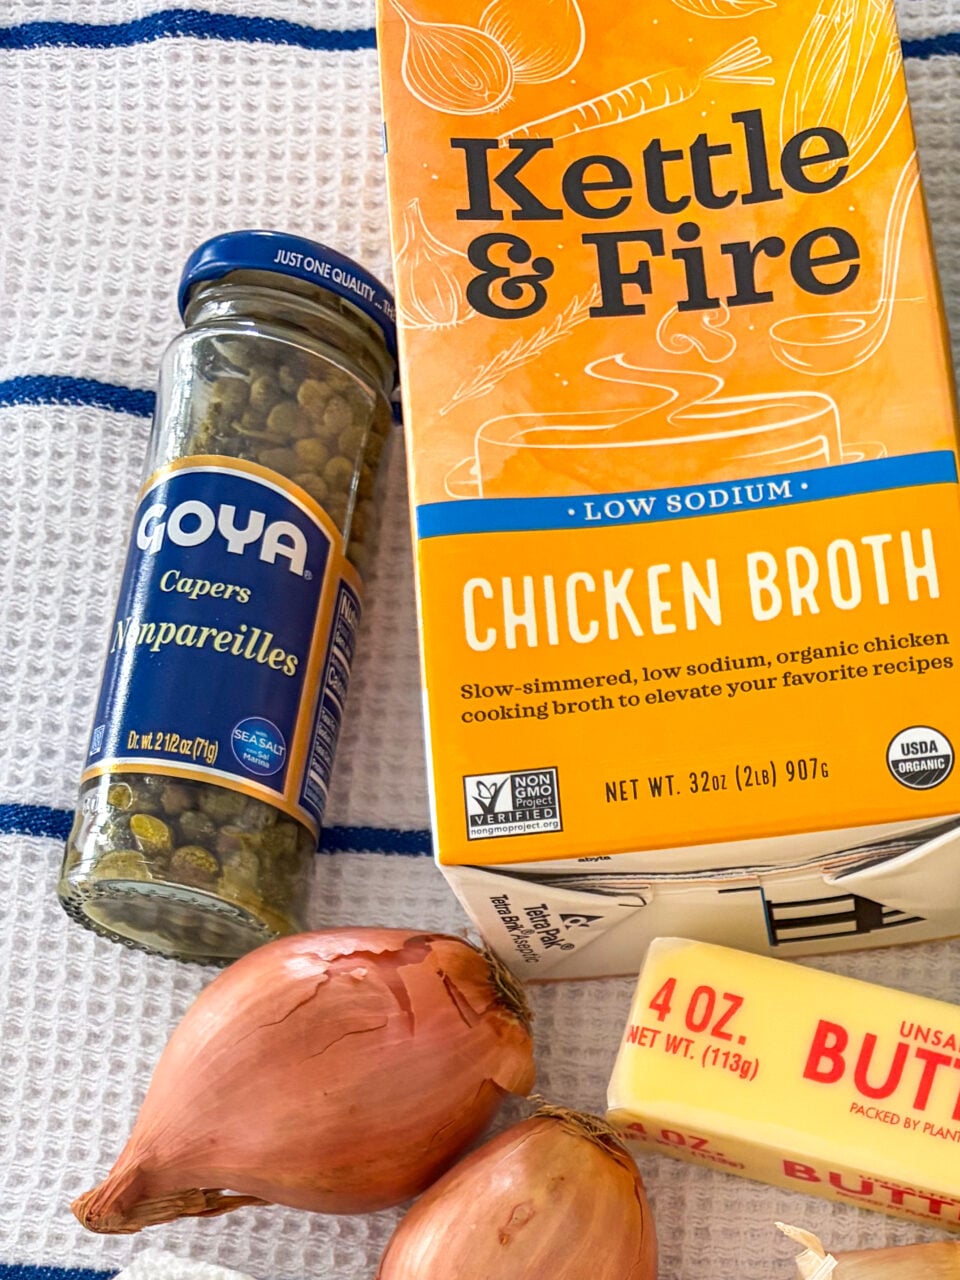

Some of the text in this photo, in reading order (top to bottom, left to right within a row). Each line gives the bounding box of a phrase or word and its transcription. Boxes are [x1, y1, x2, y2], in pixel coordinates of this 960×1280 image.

[450, 108, 850, 222] Kettle
[274, 249, 376, 302] JUST ONE QUALITY
[466, 221, 860, 319] & Fire
[584, 479, 794, 522] LOW SODIUM
[136, 500, 309, 577] GOYA
[160, 569, 251, 603] Capers
[462, 527, 940, 653] CHICKEN BROTH
[460, 632, 950, 700] Slow-simmered, low sodium, organic chicken
[461, 656, 954, 724] cooking broth to elevate your favorite recipes
[127, 730, 139, 749] Dr.
[141, 733, 152, 750] wt.
[154, 732, 164, 750] 2
[164, 733, 180, 752] 1/2
[180, 738, 192, 755] oz
[192, 736, 219, 766] (71g)
[233, 729, 286, 757] SEA SALT
[243, 752, 270, 769] Marina
[257, 750, 270, 761] Sal
[901, 739, 938, 757] USDA
[515, 774, 551, 788] NON
[898, 758, 945, 774] ORGANIC
[515, 785, 552, 799] GMO
[516, 796, 553, 810] Project
[604, 779, 639, 803] NET
[647, 774, 681, 798] WT.
[471, 820, 559, 836] nongmoproject.org
[475, 808, 554, 825] VERIFIED
[490, 894, 540, 964] Tetra Aseptic
[523, 903, 566, 950] Tetra Pak
[648, 977, 748, 1047] 4 OZ.
[626, 1024, 760, 1083] NET WT. (113g)
[849, 1102, 901, 1127] PACKED
[903, 1116, 921, 1132] BY
